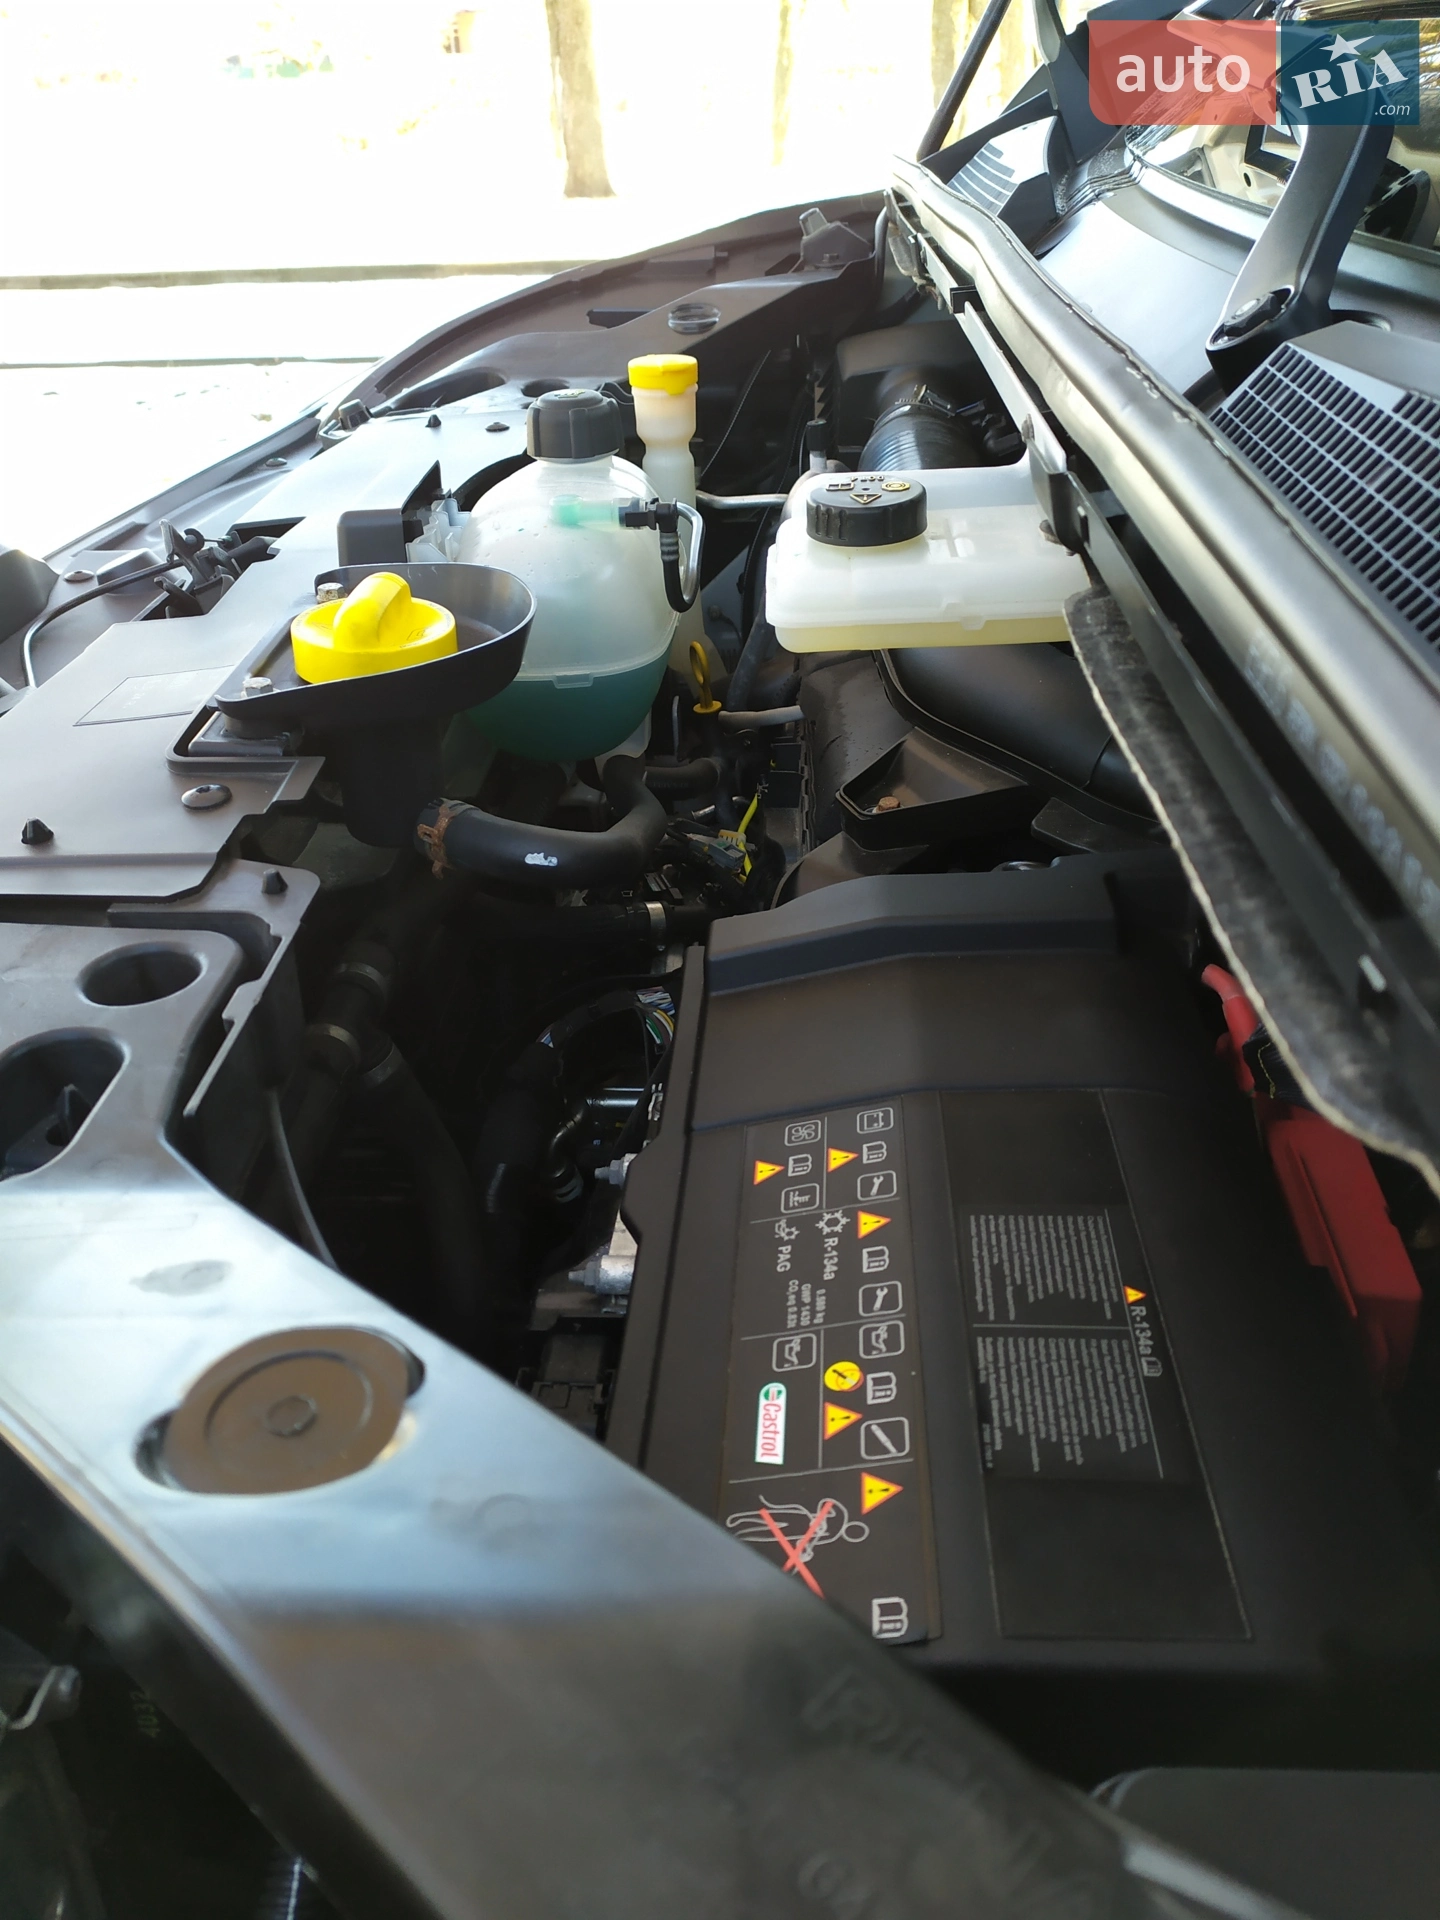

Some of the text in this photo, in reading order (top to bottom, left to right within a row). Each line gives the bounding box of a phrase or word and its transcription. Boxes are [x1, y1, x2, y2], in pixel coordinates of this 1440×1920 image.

[777, 1244, 791, 1272] PAG
[823, 1237, 838, 1280] R-134a
[799, 1283, 812, 1326] GWP 1430
[1130, 1306, 1154, 1354] R-134a
[760, 1402, 782, 1458] Castrol
